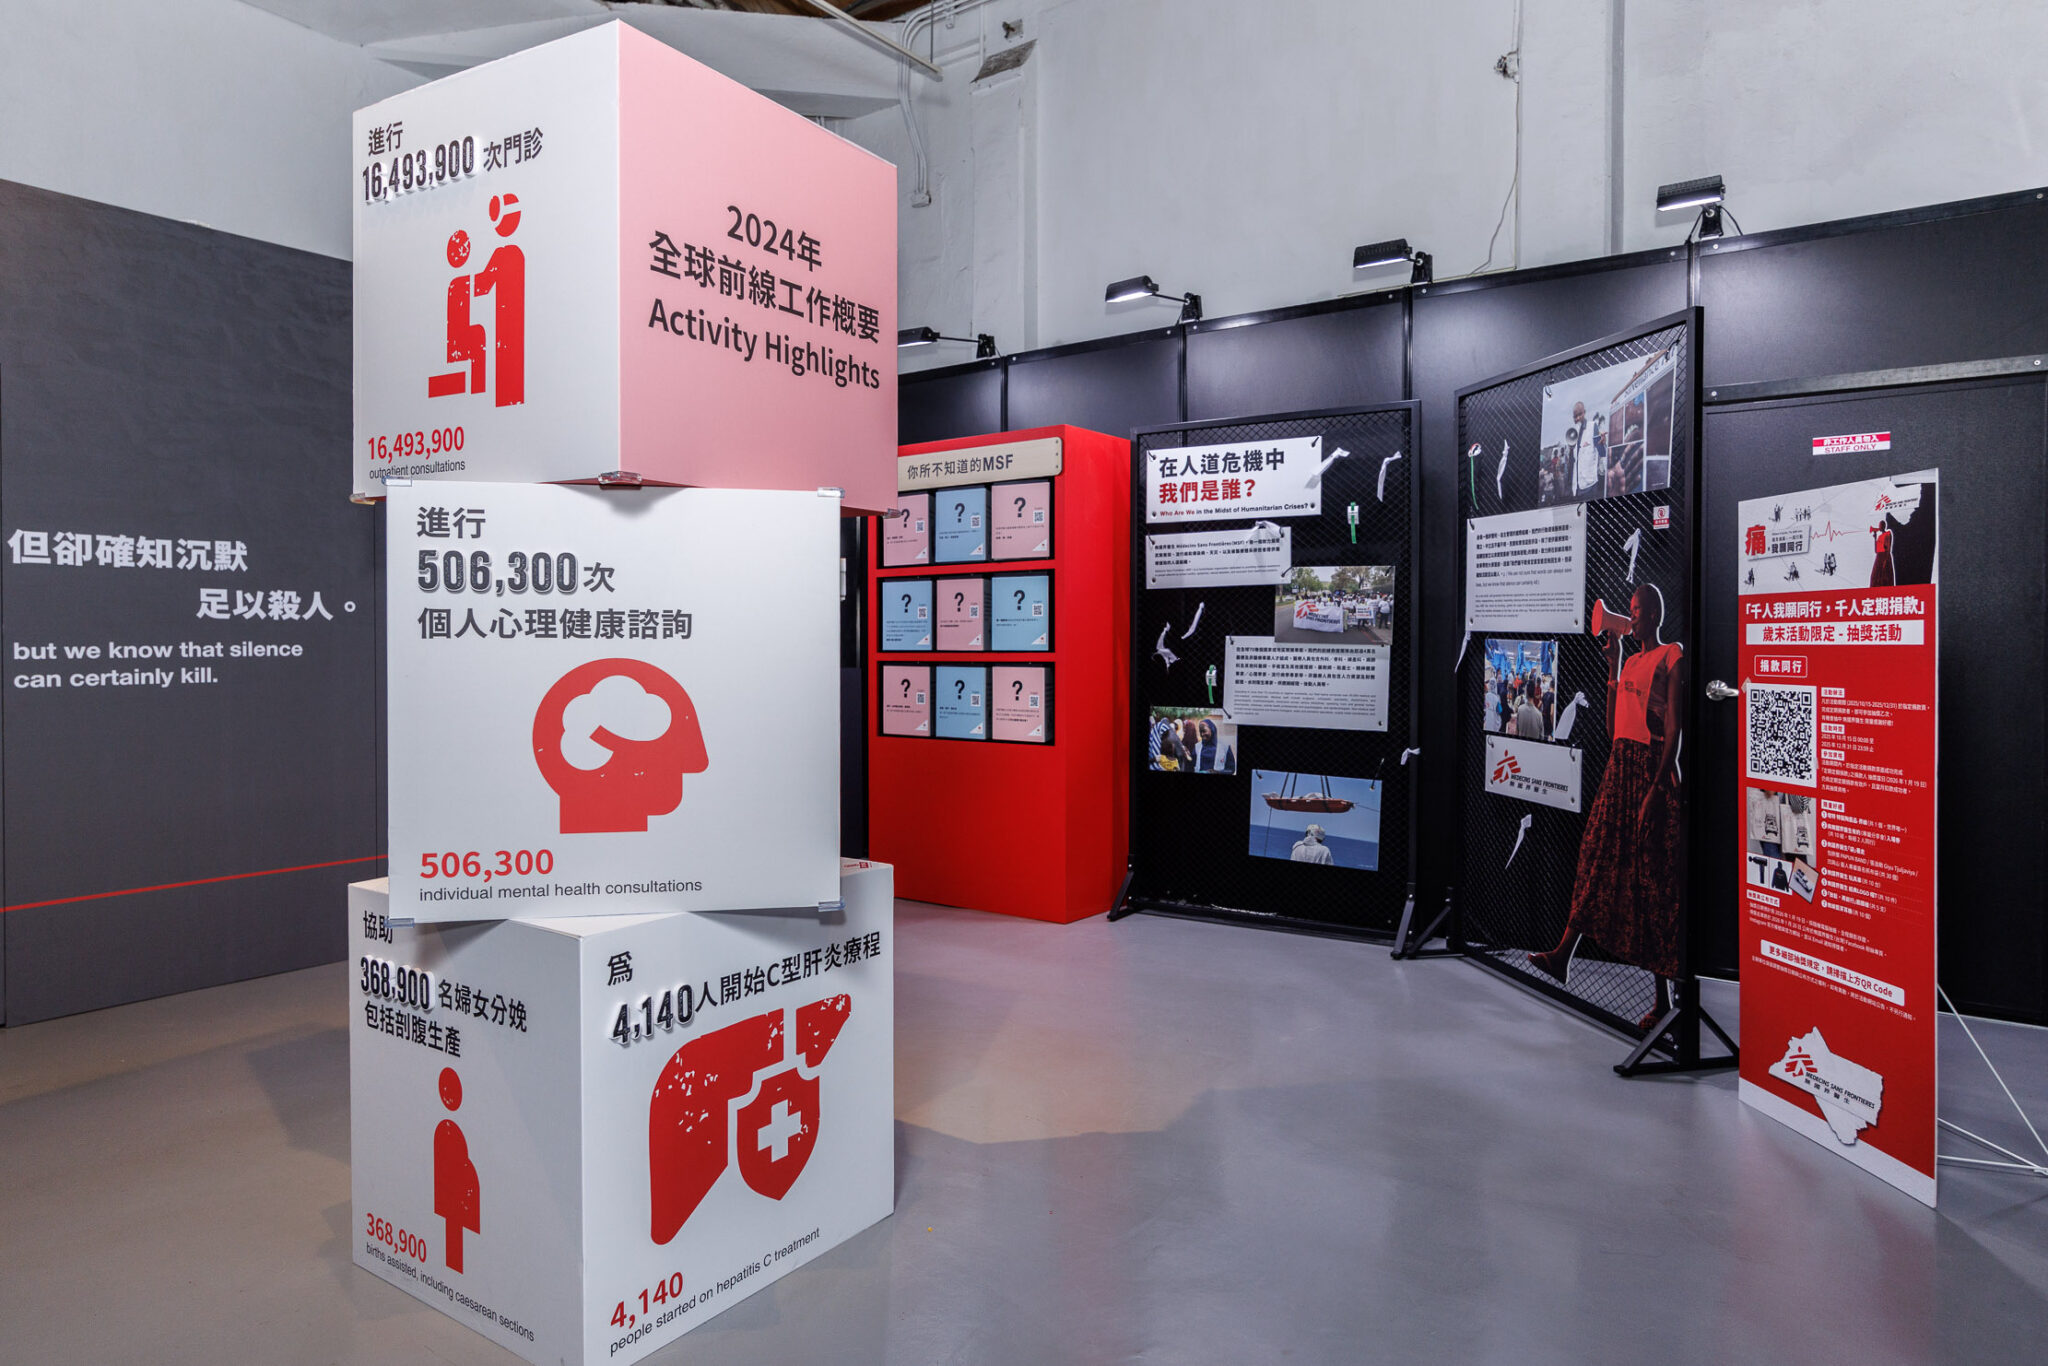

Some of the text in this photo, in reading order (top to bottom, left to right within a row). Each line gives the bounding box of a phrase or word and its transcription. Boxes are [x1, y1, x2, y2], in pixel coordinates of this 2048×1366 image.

[368, 121, 403, 156] 進行
[362, 136, 474, 201] 16,493,900
[727, 205, 822, 272] 2024年
[648, 298, 880, 389] Activity Highlights
[368, 426, 464, 463] 16,493,900
[1825, 446, 1851, 454] STAFF
[411, 460, 465, 475] consultations
[907, 454, 1013, 480] 你所不知道的MSF
[1159, 448, 1285, 478] 在人道危機中
[417, 507, 486, 538] 進行
[954, 503, 965, 523] ?
[1013, 497, 1026, 518] ?
[1241, 504, 1282, 512] Humanitarian
[7, 529, 248, 572] 但卻確知沉默
[901, 593, 912, 613] ?
[954, 592, 964, 612] ?
[1013, 590, 1025, 610] ?
[417, 607, 692, 639] 個人心理健康諮詢
[14, 642, 303, 660] but we know that silence
[14, 667, 218, 688] can certainly kill.
[901, 679, 911, 698] ?
[954, 680, 965, 700] ?
[1012, 680, 1023, 701] ?
[420, 849, 553, 882] 506,300
[420, 880, 702, 901] individual mental health consultations
[361, 957, 430, 1009] 368,900
[1873, 983, 1893, 998] Code
[364, 1000, 461, 1058] 包括剖腹生產
[1806, 1072, 1875, 1109] MEDECINS SANS FRONTIERES
[366, 1213, 426, 1263] 368,900
[366, 1242, 535, 1342] births assisted, including caesarean sections
[610, 1227, 820, 1357] people started on hepatitis C treatment
[610, 1272, 683, 1329] 4,140
